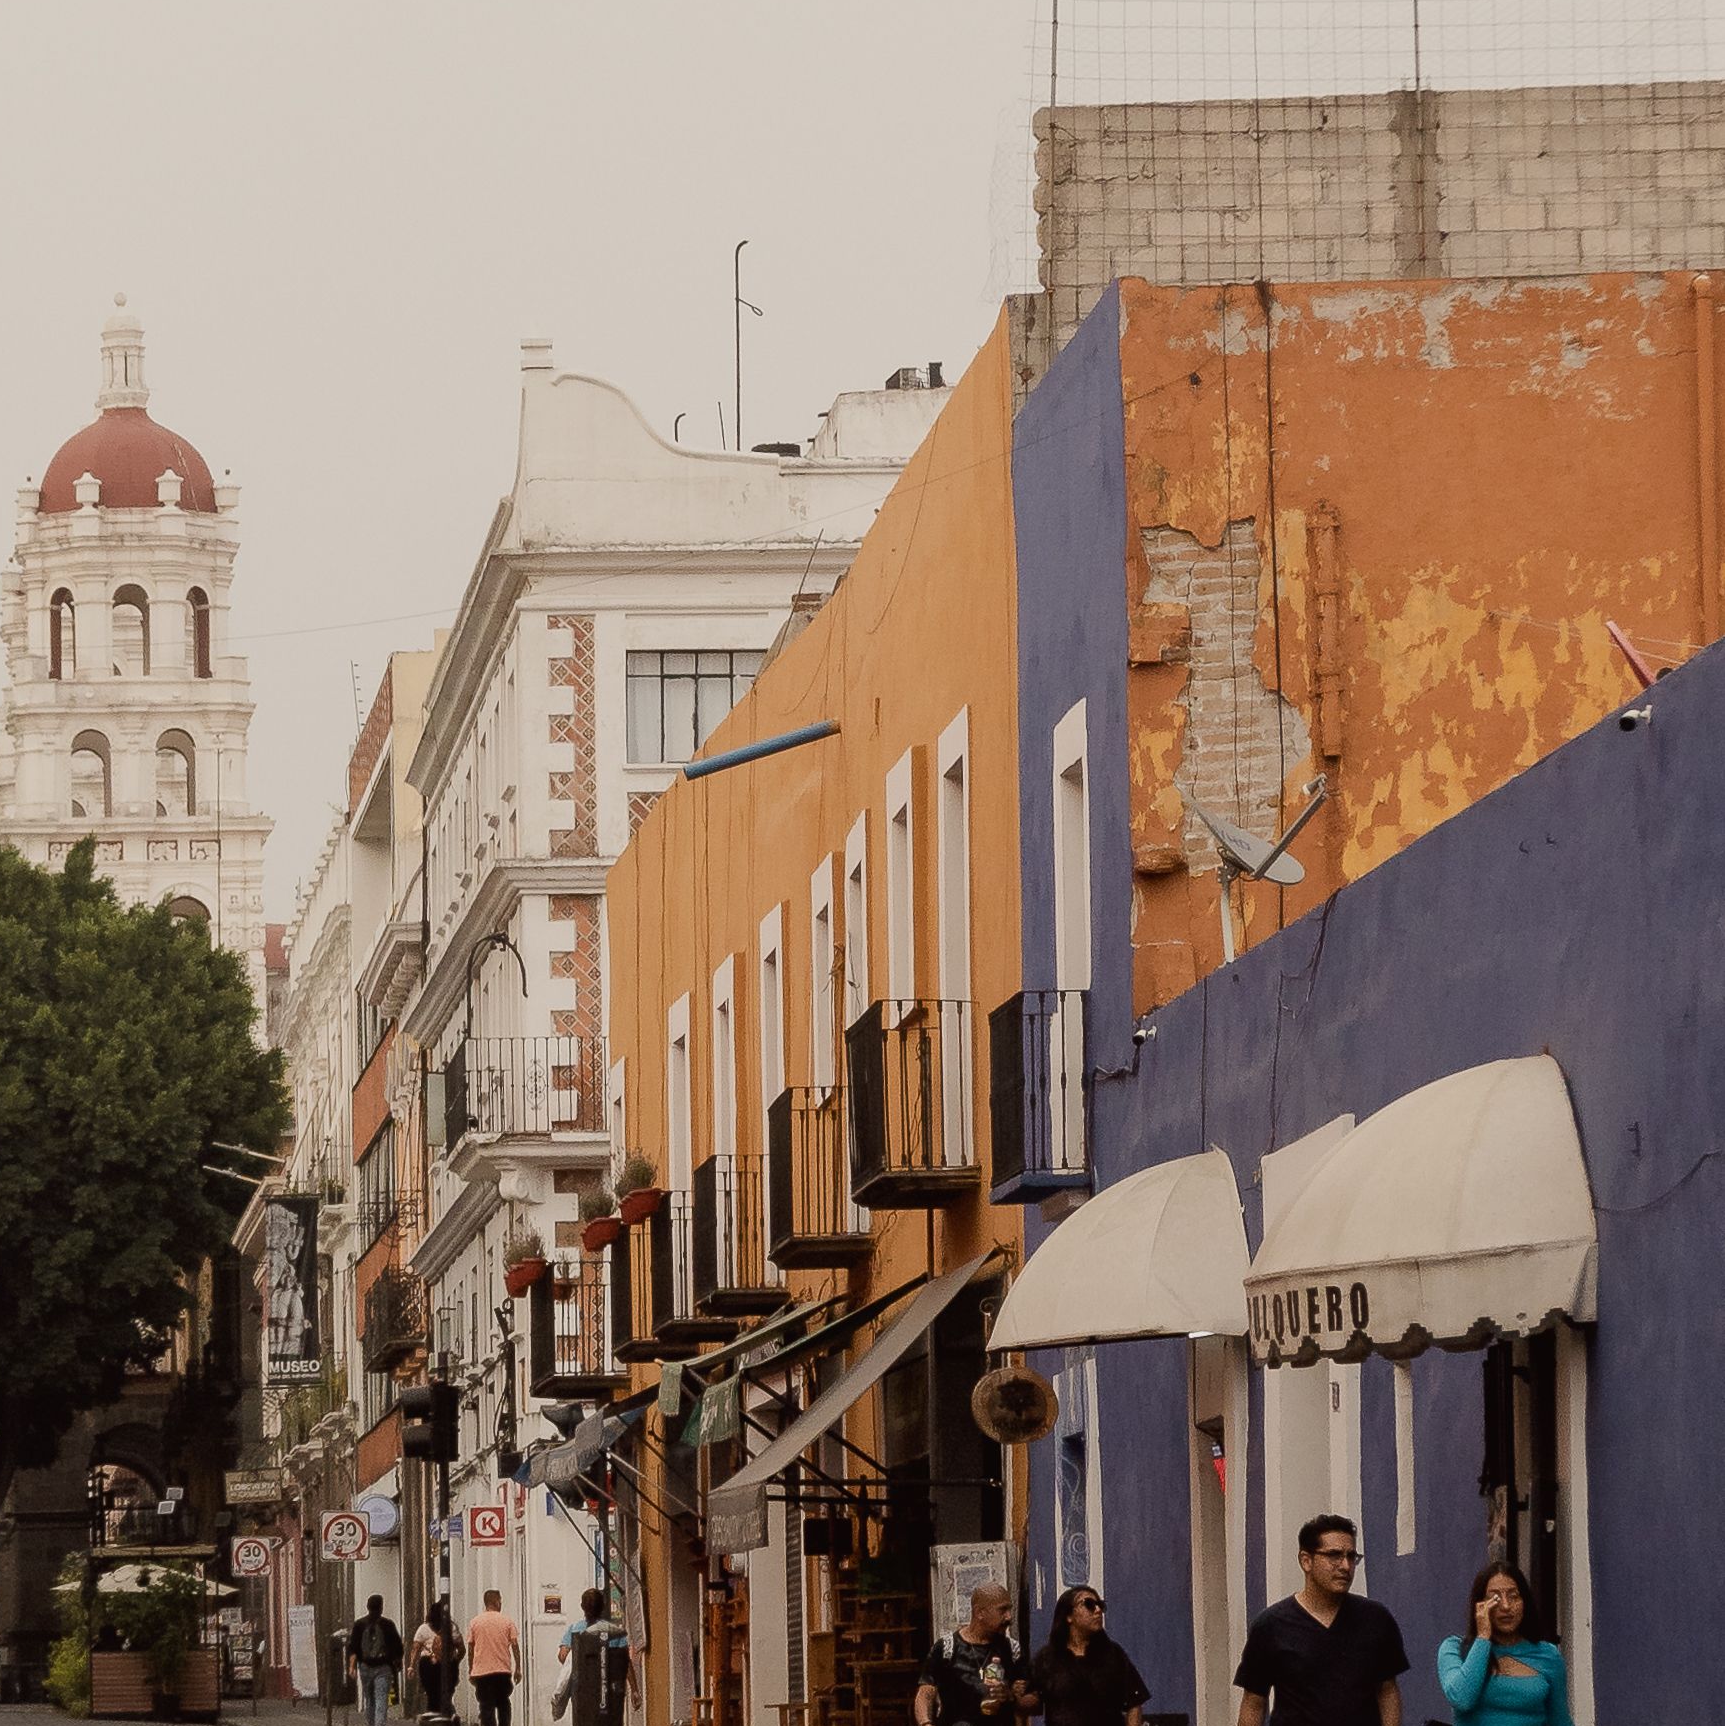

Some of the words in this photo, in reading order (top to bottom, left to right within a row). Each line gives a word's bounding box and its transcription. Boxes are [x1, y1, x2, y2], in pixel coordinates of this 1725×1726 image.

[268, 1360, 321, 1374] MUSEO
[334, 1521, 357, 1537] 30
[481, 1516, 497, 1533] K
[243, 1545, 261, 1558] 30
